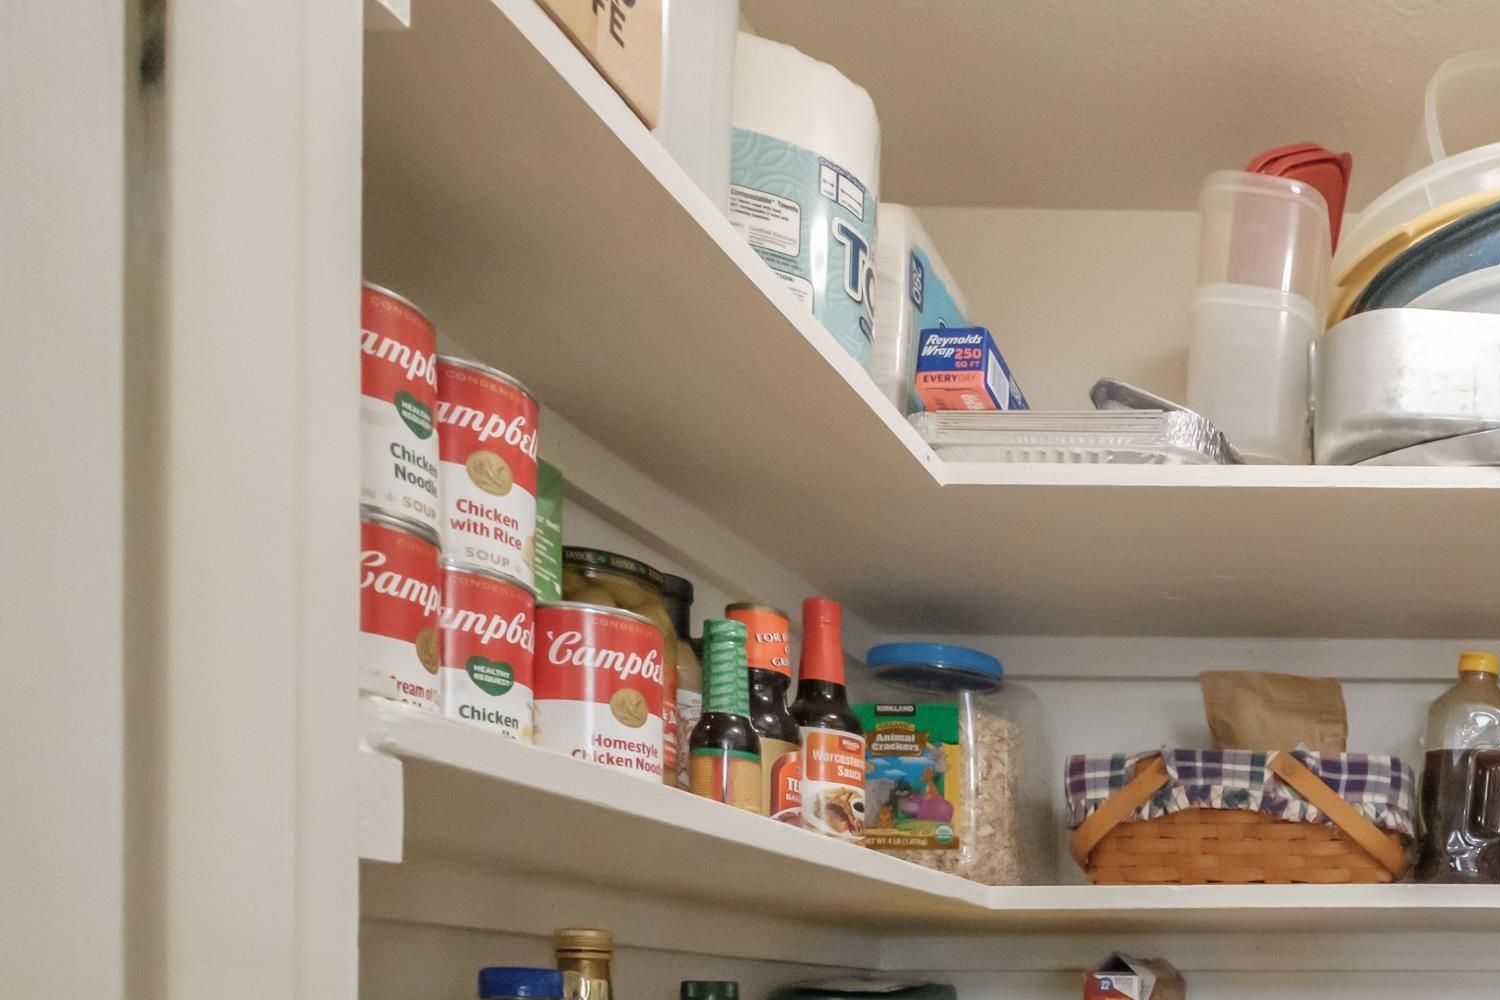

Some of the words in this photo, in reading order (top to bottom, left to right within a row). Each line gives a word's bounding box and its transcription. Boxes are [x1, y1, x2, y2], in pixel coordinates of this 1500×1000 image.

[926, 334, 983, 347] Reynolds
[921, 345, 955, 358] Wrap
[954, 348, 982, 359] 250
[361, 329, 438, 393] ampb
[923, 374, 976, 383] EVERYDAY
[456, 498, 519, 530] Chicken
[450, 518, 491, 538] with
[494, 528, 522, 551] Rice
[465, 546, 511, 568] SOUP
[756, 633, 781, 643] FOR
[546, 630, 665, 687] Campbel
[473, 665, 511, 678] HEALTHY
[473, 673, 513, 687] REQUEST
[877, 705, 914, 713] KIRKLAND
[459, 704, 519, 730] Chicken
[875, 733, 916, 743] Animal
[592, 734, 659, 759] Homestyle
[871, 742, 921, 752] Crackers
[837, 765, 862, 782] Sauce
